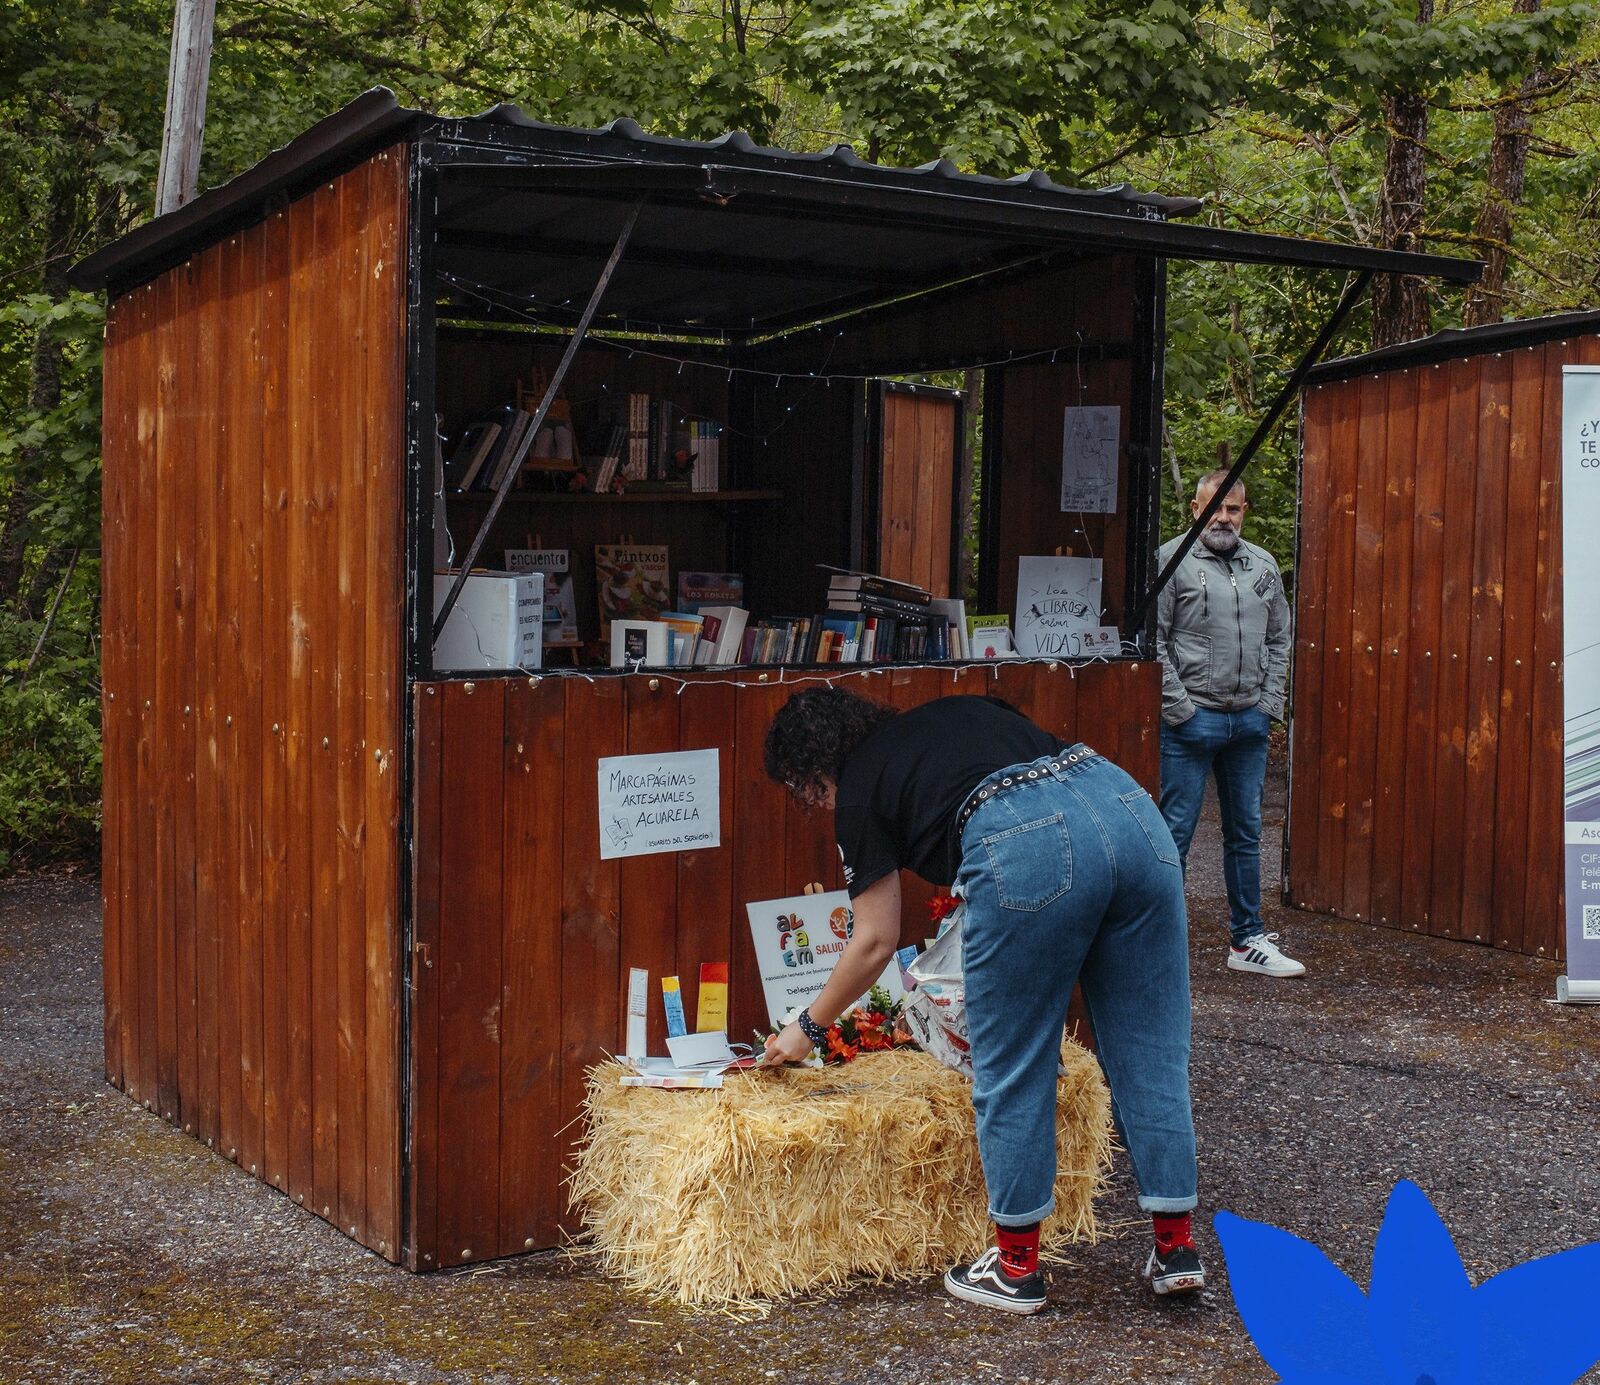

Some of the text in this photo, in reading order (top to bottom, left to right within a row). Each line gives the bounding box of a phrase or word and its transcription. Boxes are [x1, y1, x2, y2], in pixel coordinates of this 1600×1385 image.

[1580, 440, 1596, 454] TE
[614, 550, 667, 563] Pintxos
[1043, 600, 1082, 614] LIBROS
[621, 791, 696, 807] ARTESANALES
[635, 807, 700, 828] ACUARELA
[815, 941, 844, 956] SALUD
[786, 982, 826, 995] Delegació
